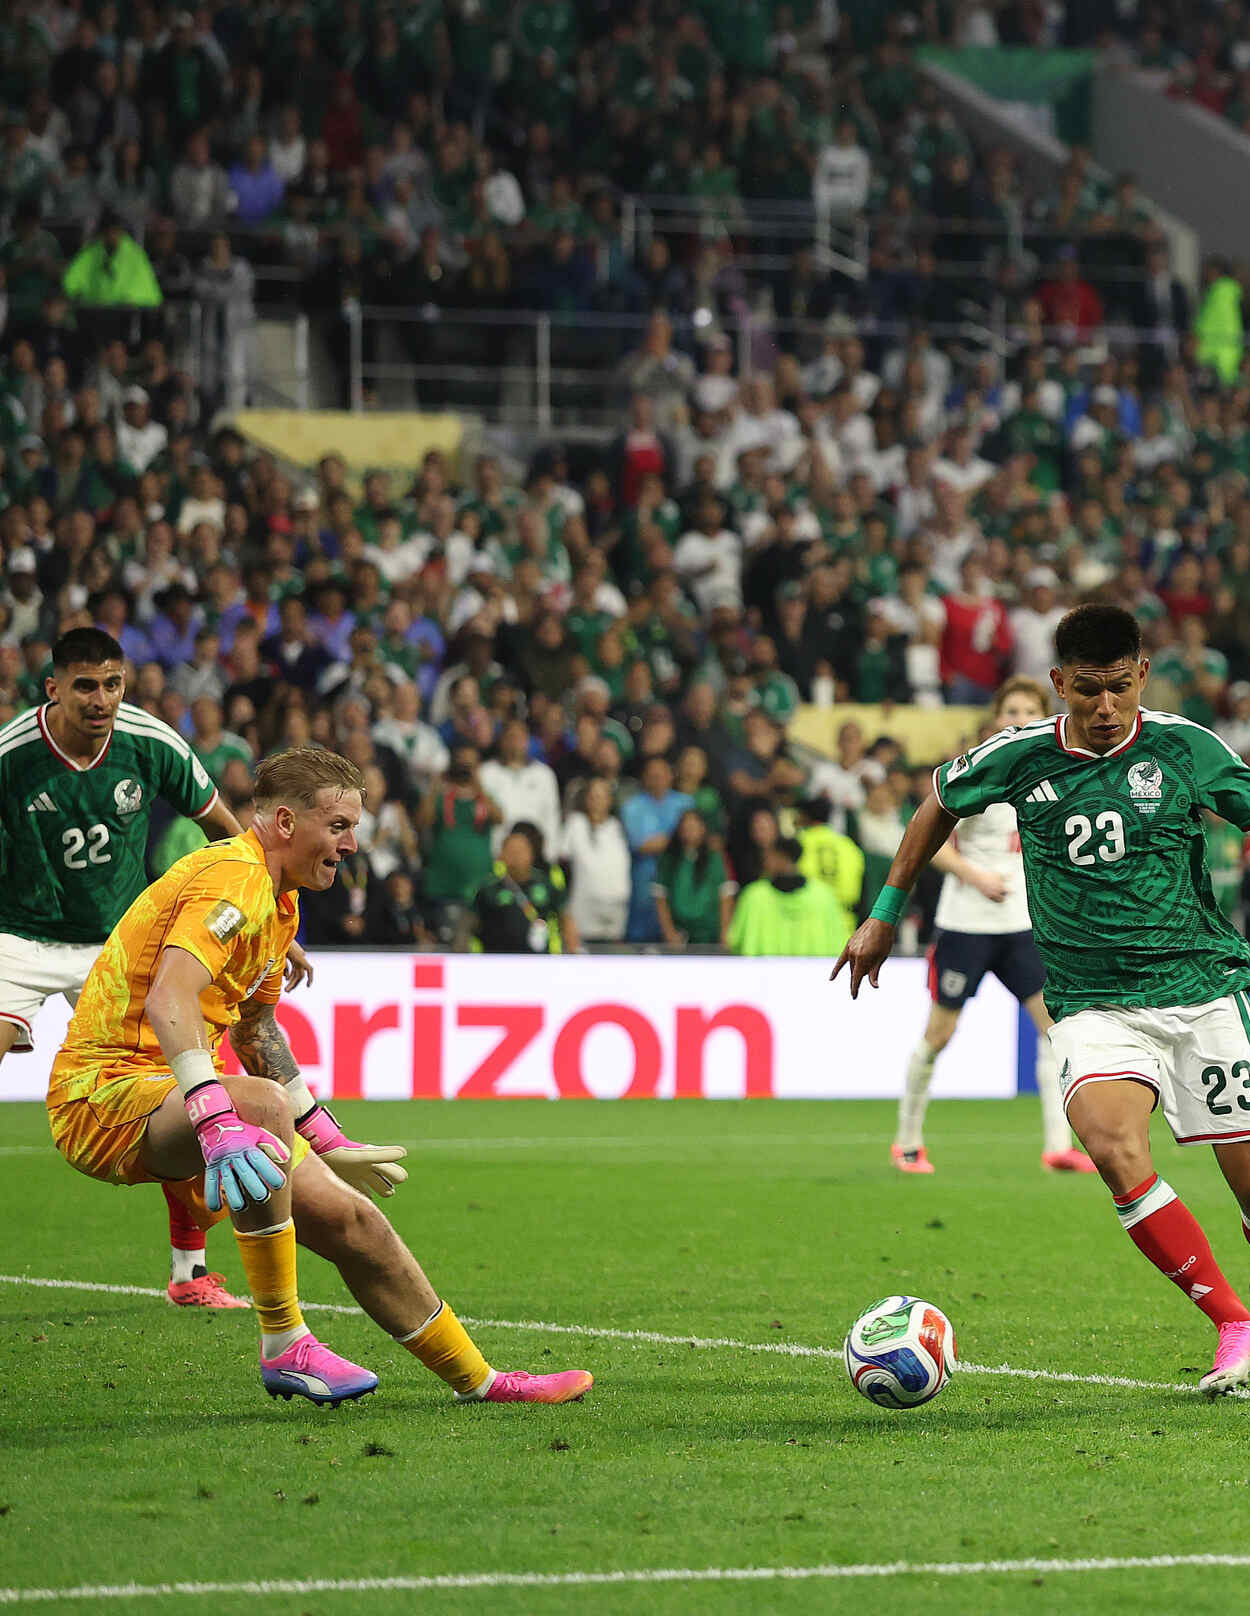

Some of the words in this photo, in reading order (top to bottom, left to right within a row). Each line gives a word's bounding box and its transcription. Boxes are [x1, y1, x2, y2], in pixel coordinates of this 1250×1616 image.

[62, 823, 111, 869] 22
[1065, 811, 1126, 866] 23
[218, 957, 776, 1098] erizon
